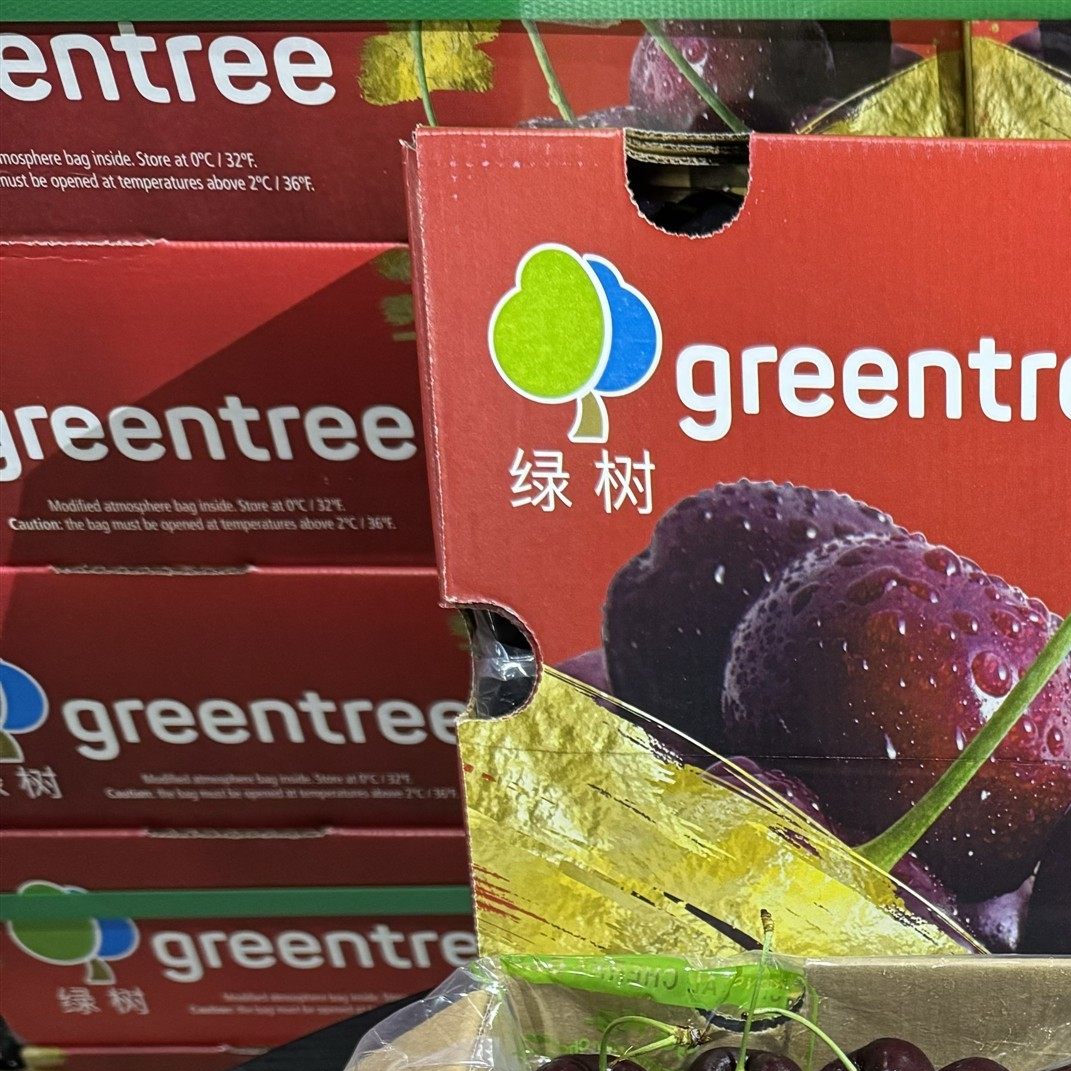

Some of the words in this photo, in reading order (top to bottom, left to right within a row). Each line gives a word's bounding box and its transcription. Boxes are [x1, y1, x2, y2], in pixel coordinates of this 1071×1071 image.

[63, 150, 91, 170] bag
[92, 150, 135, 167] inside.
[136, 151, 172, 167] Store
[174, 153, 189, 168] at
[28, 172, 48, 188] be
[51, 172, 100, 192] opened
[102, 175, 116, 189] at
[118, 175, 204, 193] temperatures
[206, 174, 246, 191] above
[507, 448, 656, 515] 绿树
[152, 924, 477, 984] greentre
